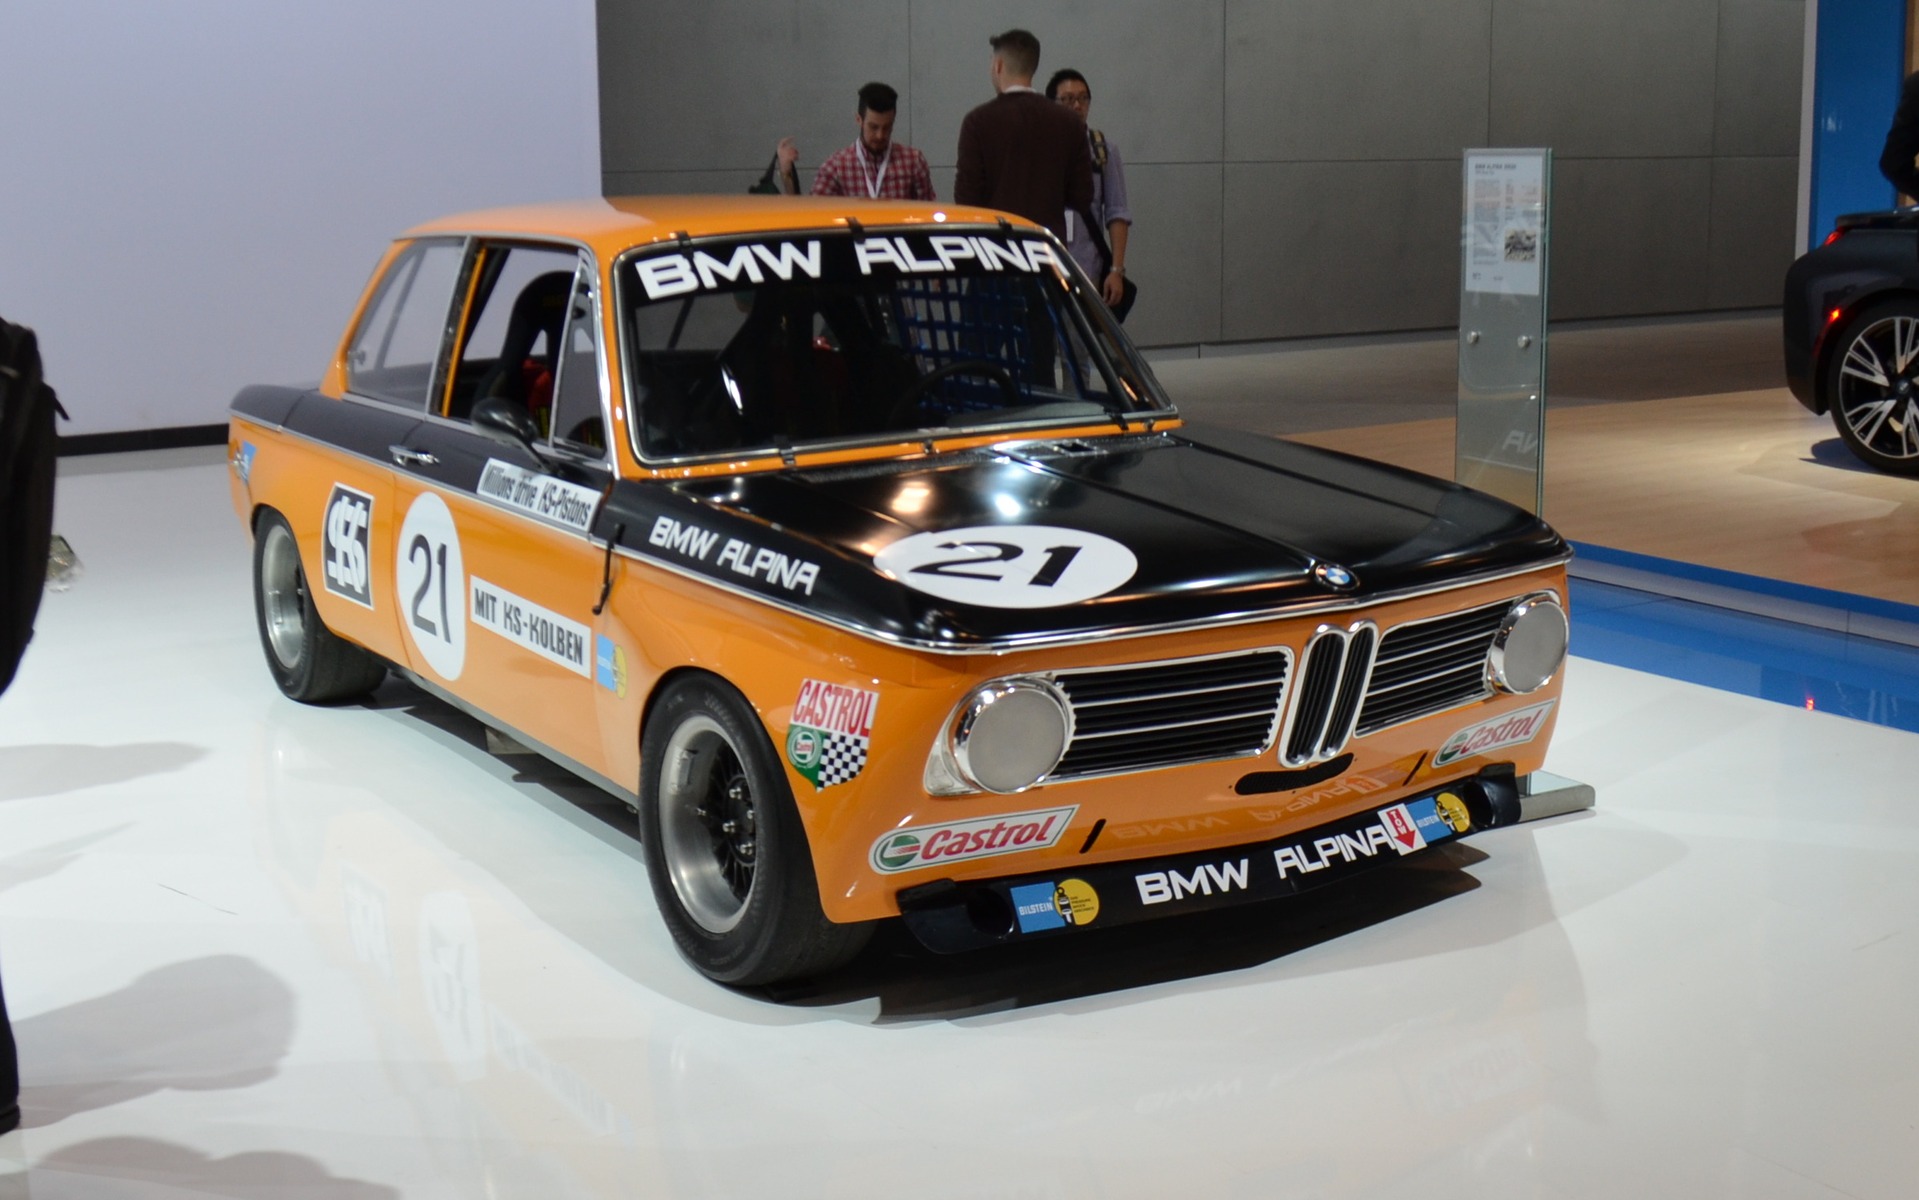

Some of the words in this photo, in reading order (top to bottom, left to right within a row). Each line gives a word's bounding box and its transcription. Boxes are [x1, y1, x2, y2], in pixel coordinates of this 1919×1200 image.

[635, 240, 820, 299] BMW
[855, 236, 1070, 278] ALPINA
[513, 474, 538, 508] drive
[537, 481, 591, 527] KS-Pistons
[649, 516, 720, 561] BMW
[716, 538, 821, 596] ALPINA
[908, 541, 1084, 588] 21
[408, 533, 452, 644] 21
[474, 587, 498, 623] MIT
[503, 601, 583, 666] KS-KOLBEN
[793, 680, 874, 737] CASTROL
[1460, 709, 1543, 755] Castrol
[921, 815, 1057, 861] Castrol
[1389, 810, 1409, 835] TOW
[1135, 858, 1249, 905] BMW
[1274, 824, 1398, 879] ALPINA
[1018, 901, 1054, 916] BILSTEIN
